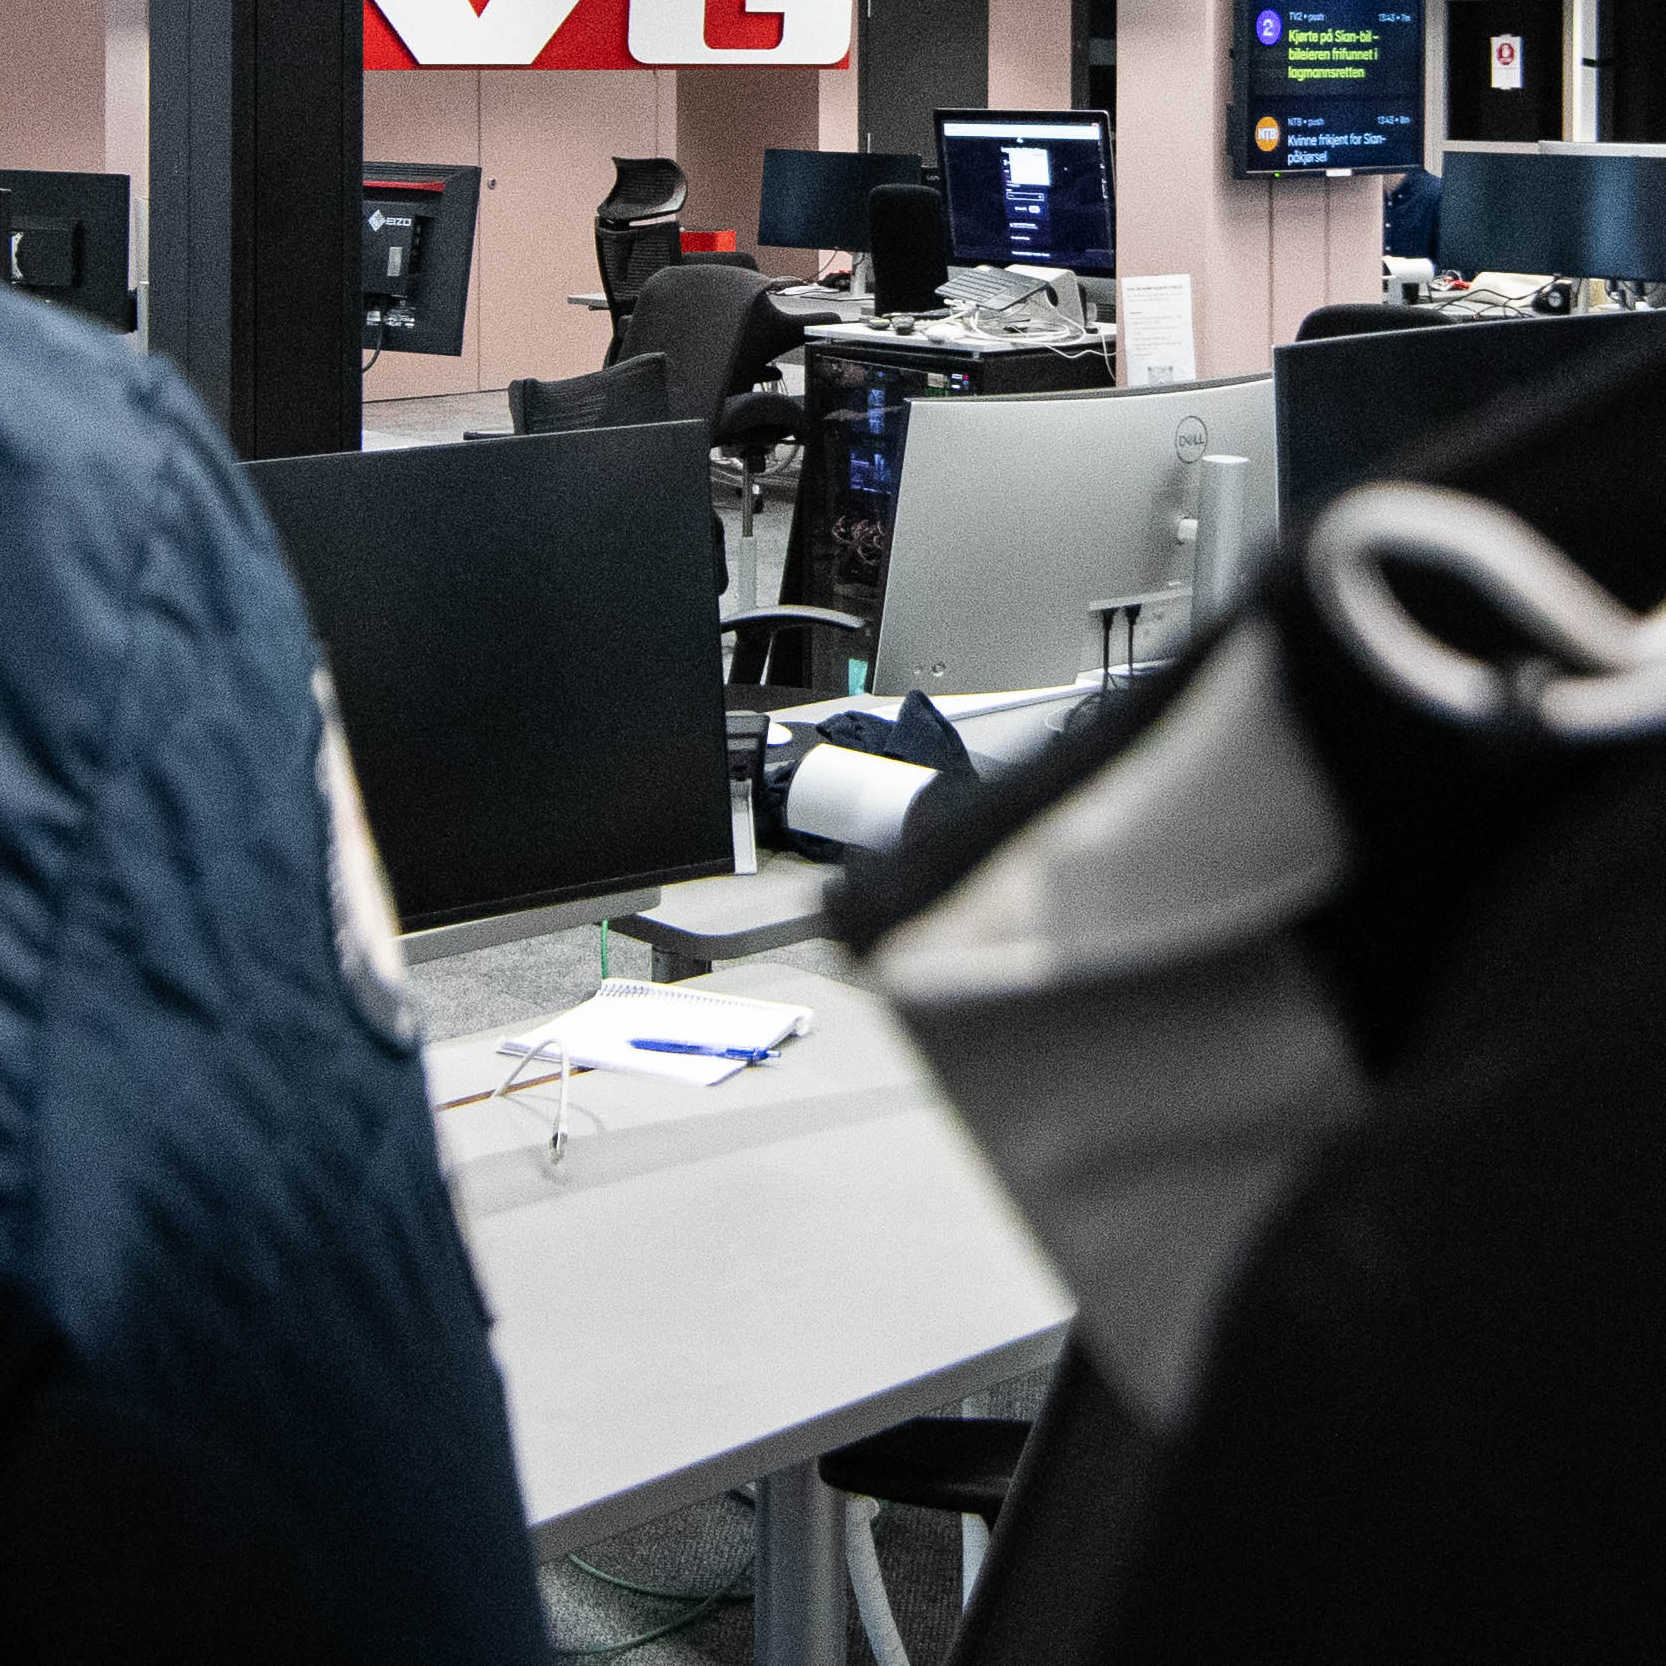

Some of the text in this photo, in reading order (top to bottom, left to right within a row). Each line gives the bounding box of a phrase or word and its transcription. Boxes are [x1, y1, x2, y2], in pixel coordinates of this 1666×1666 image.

[1263, 19, 1273, 36] 2
[1320, 28, 1333, 45] på
[1288, 66, 1365, 82] lagmannsretten
[1288, 135, 1317, 146] Kvinne
[386, 217, 412, 227] EIZO
[1179, 433, 1204, 447] DELL
